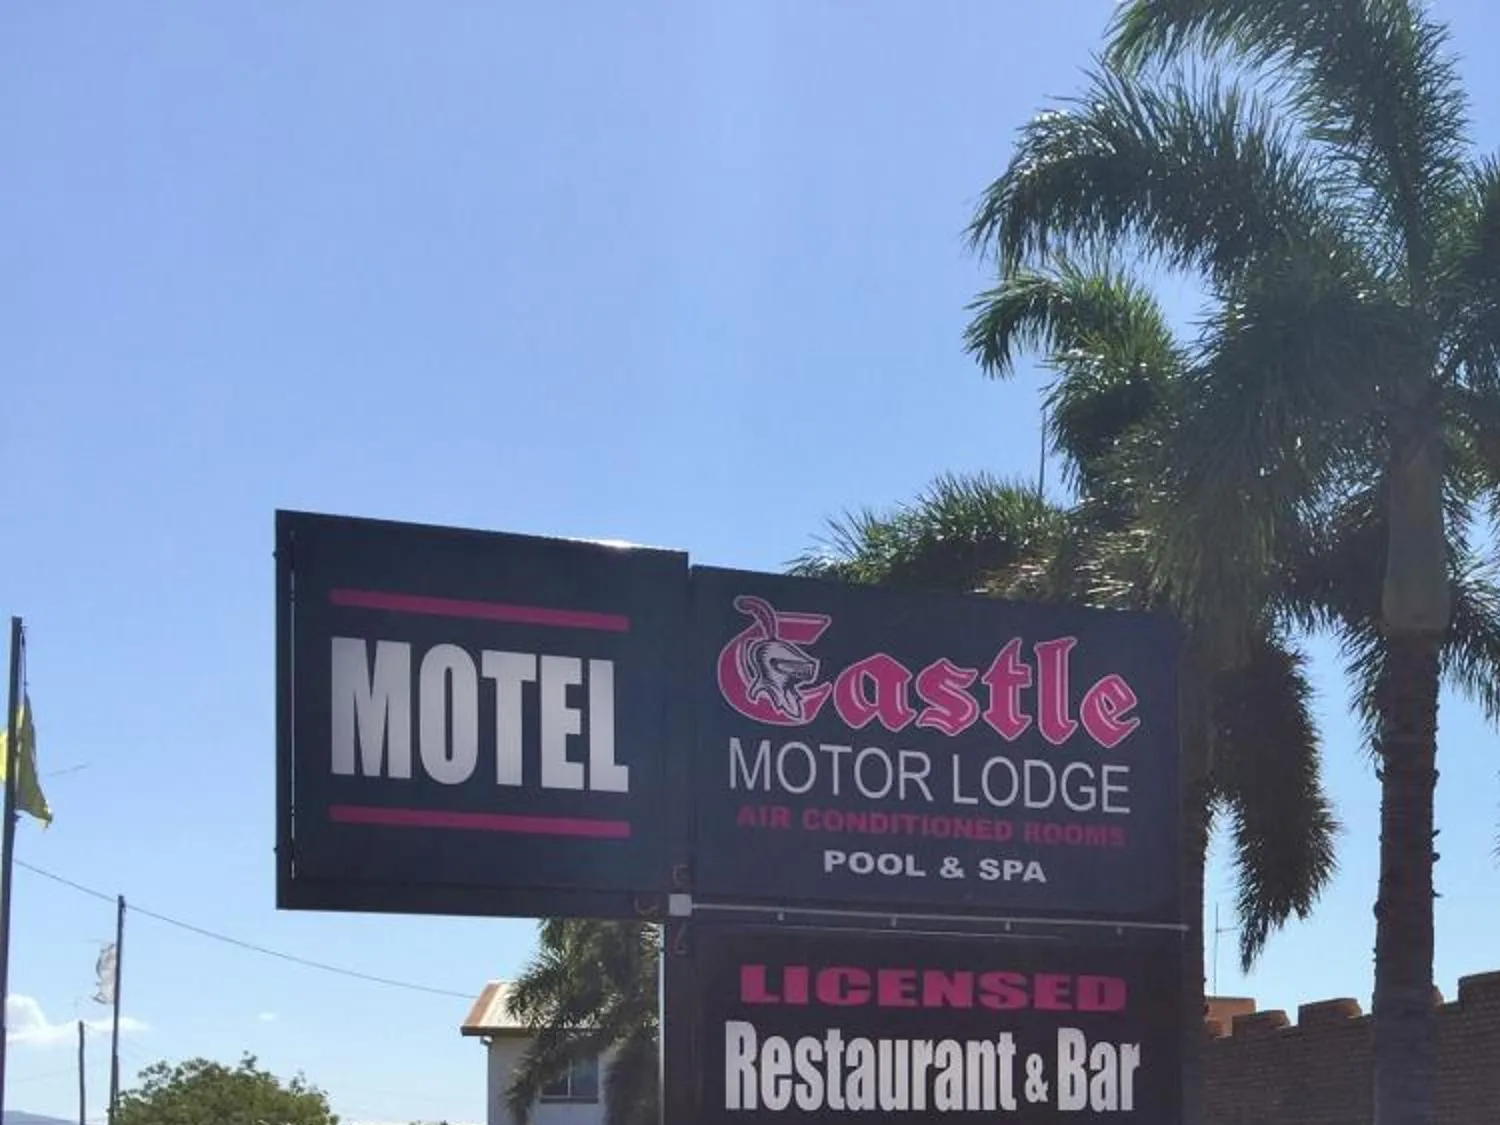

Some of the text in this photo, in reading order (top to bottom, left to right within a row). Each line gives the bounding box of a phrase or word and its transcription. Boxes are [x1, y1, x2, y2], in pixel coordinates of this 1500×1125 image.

[717, 596, 1141, 748] Castle
[330, 636, 630, 793] MOTEL
[728, 737, 1131, 815] MOTOR LODGE
[736, 806, 1128, 847] AIR CONDITIONED ROOMS
[823, 850, 1048, 883] POOL & SPA
[740, 963, 1128, 1011] LICENSED
[725, 1020, 1141, 1112] Restaurant & Bar
